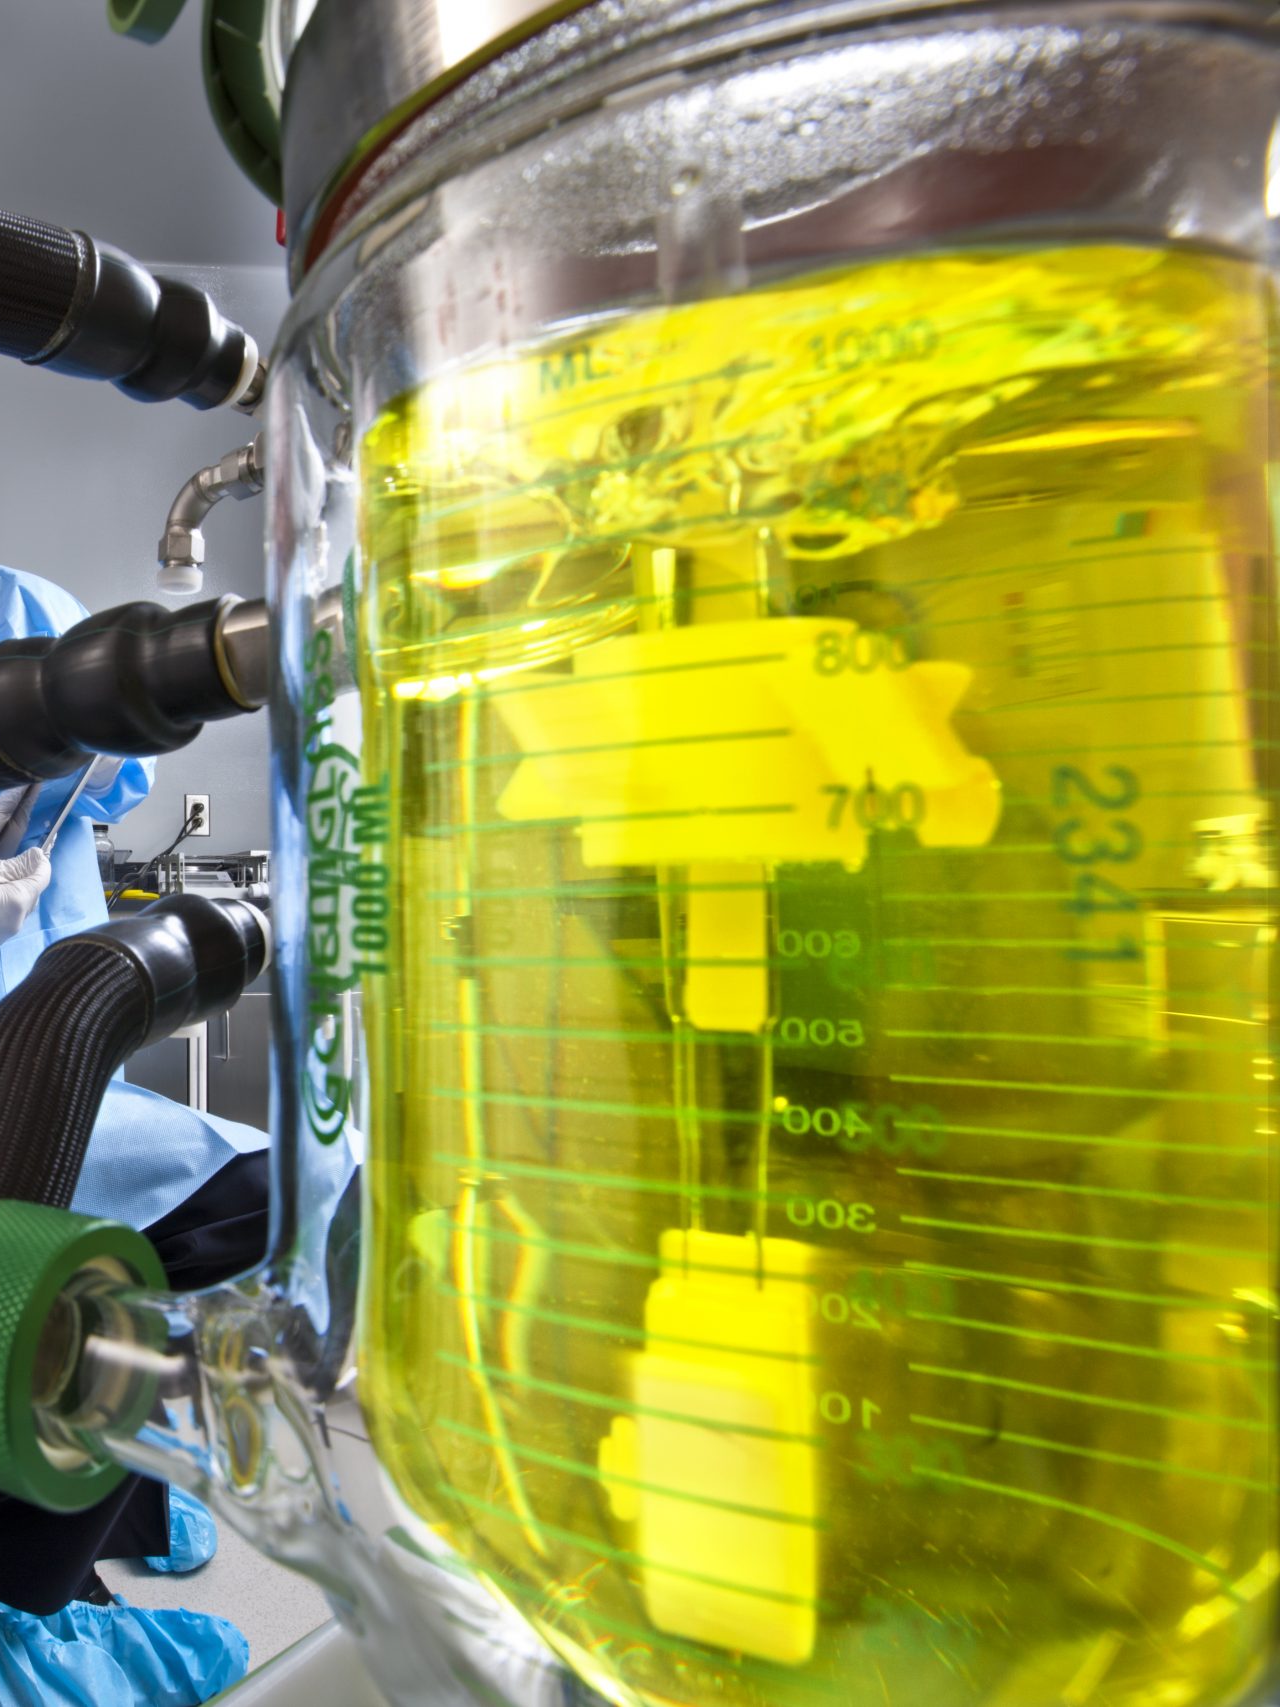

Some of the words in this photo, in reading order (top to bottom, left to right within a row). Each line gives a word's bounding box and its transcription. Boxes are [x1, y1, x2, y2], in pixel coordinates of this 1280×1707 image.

[814, 630, 911, 677] 800
[352, 772, 390, 844] ML
[818, 781, 927, 832] 700
[1051, 765, 1144, 962] 2341
[352, 864, 391, 974] 1000
